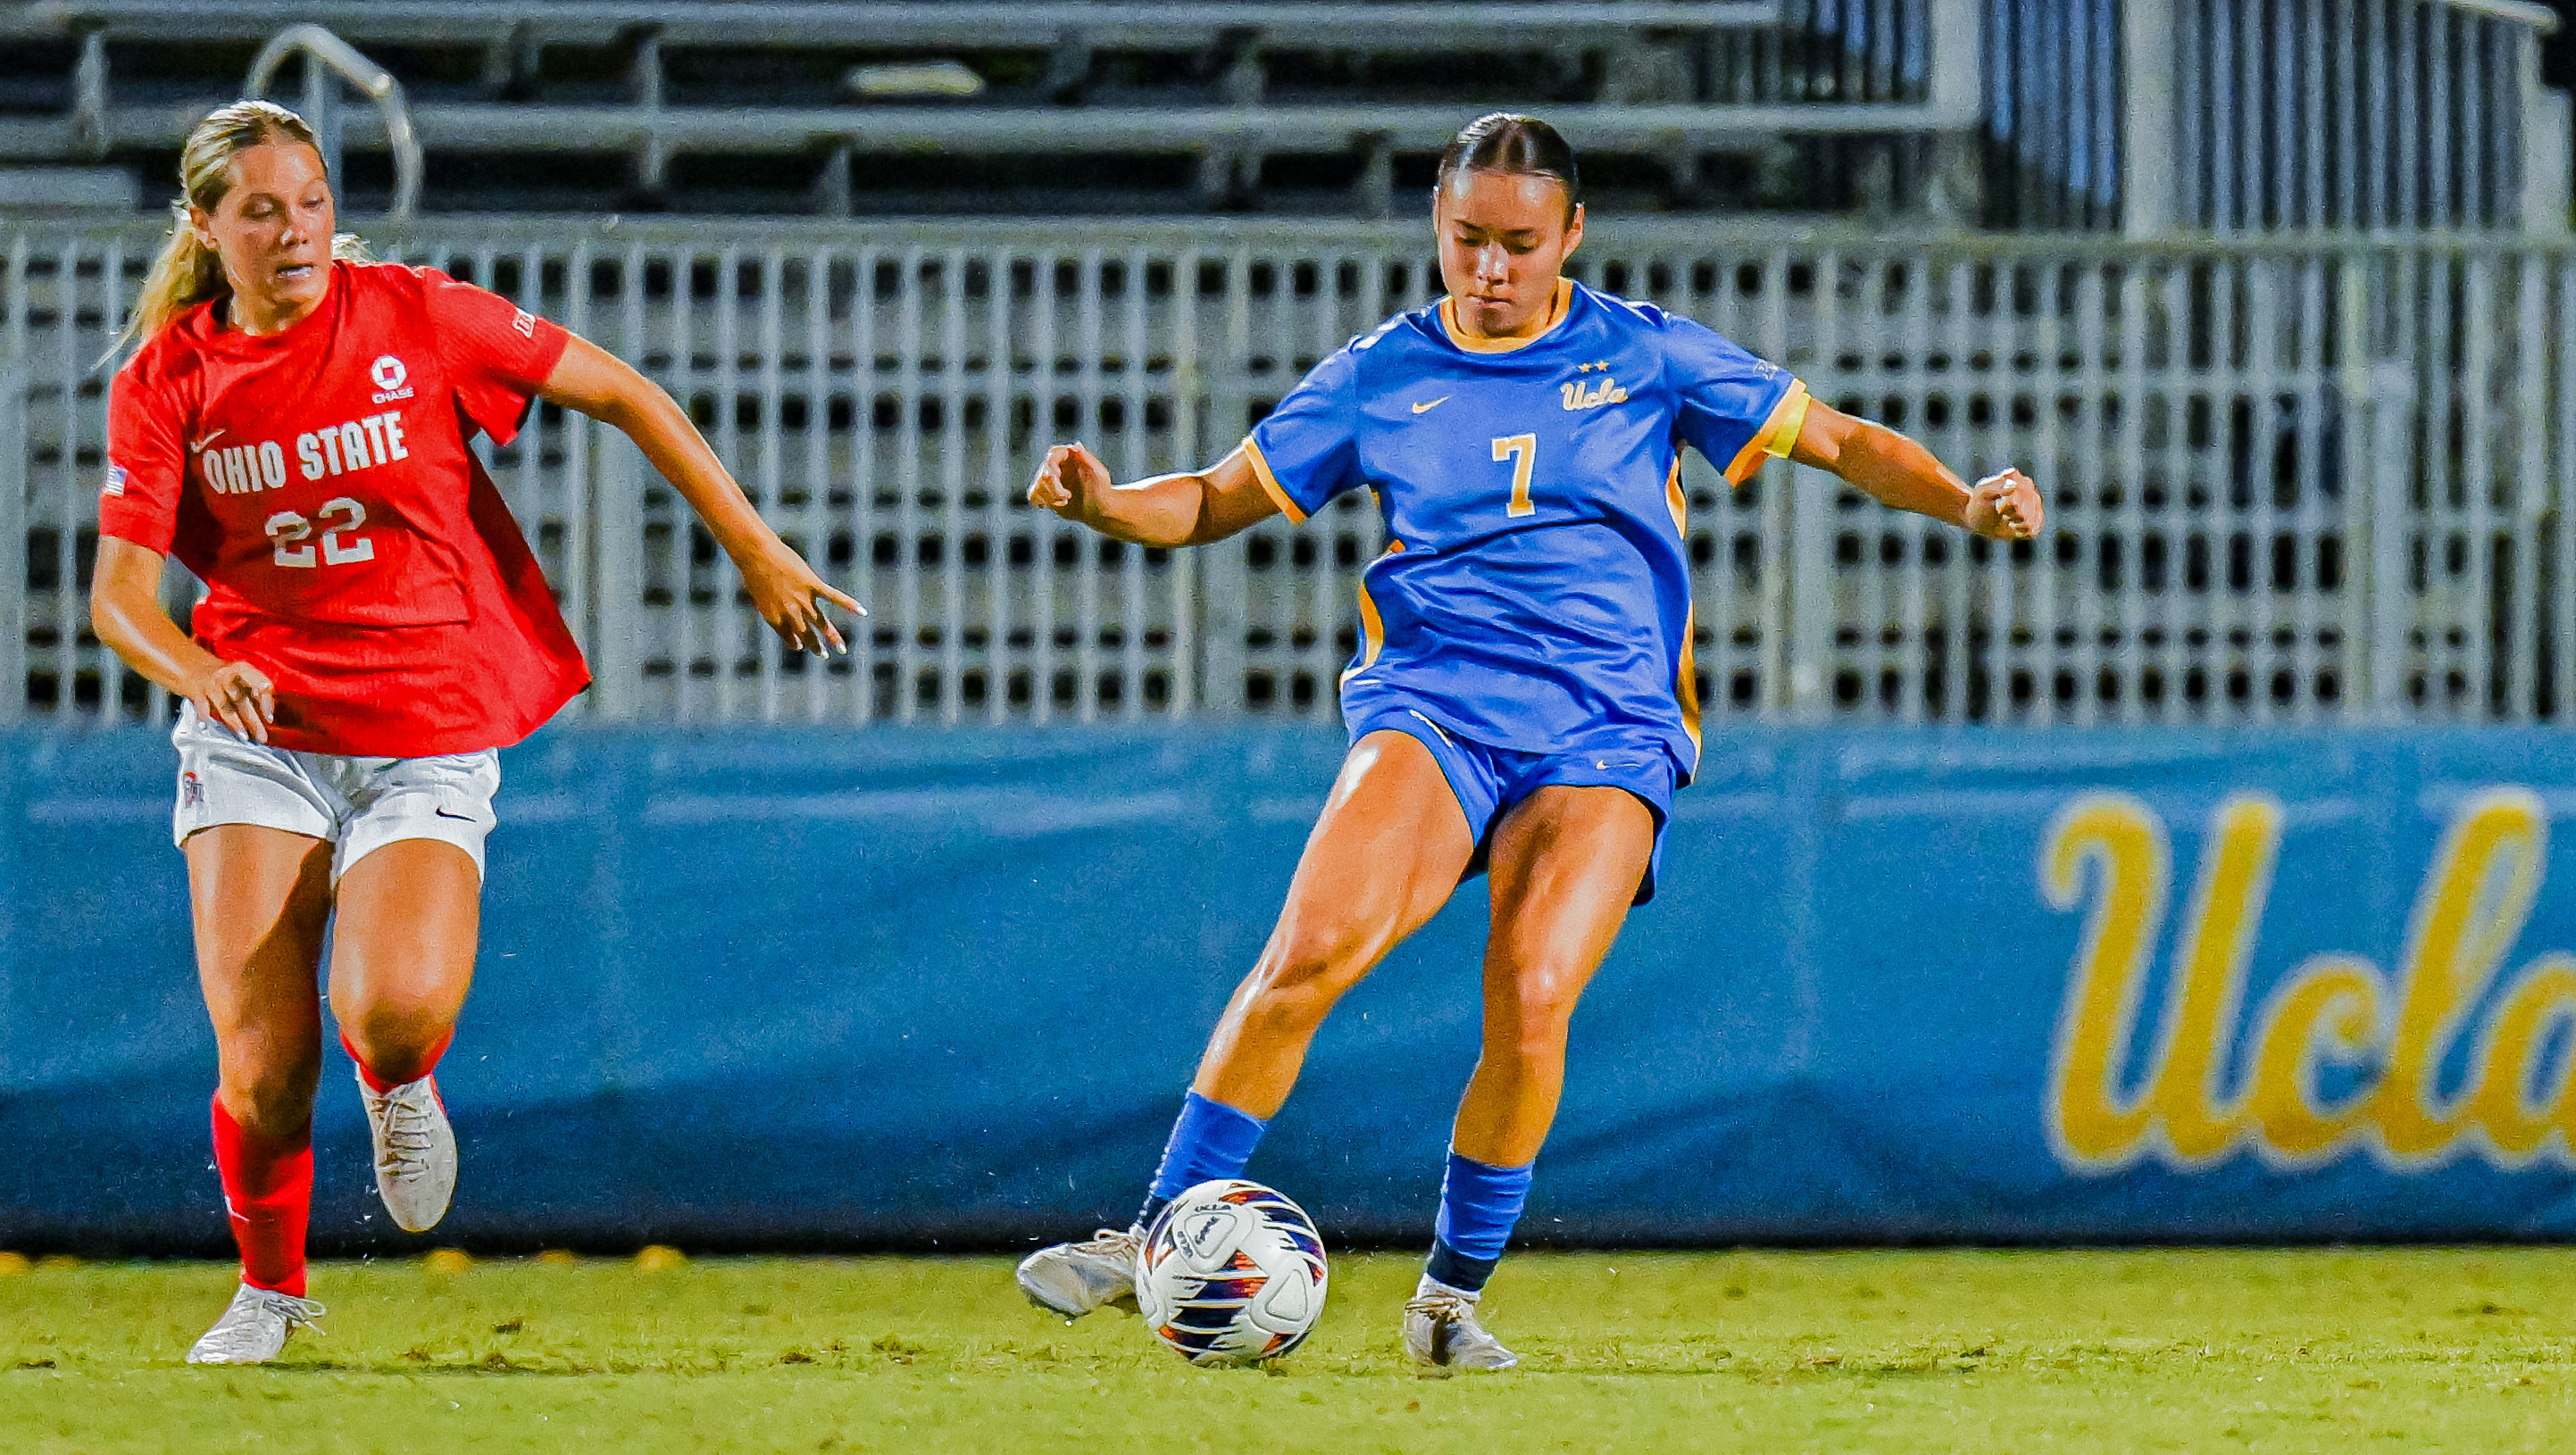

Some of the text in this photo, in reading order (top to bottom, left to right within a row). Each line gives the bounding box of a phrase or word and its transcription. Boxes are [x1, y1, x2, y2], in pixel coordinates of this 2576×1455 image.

[371, 387, 414, 404] CHASE
[1559, 378, 1629, 412] Ucla
[203, 411, 409, 495] OHIO STATE
[1491, 432, 1537, 519] 7
[264, 496, 375, 569] 22
[2038, 787, 2576, 1175] Ucla
